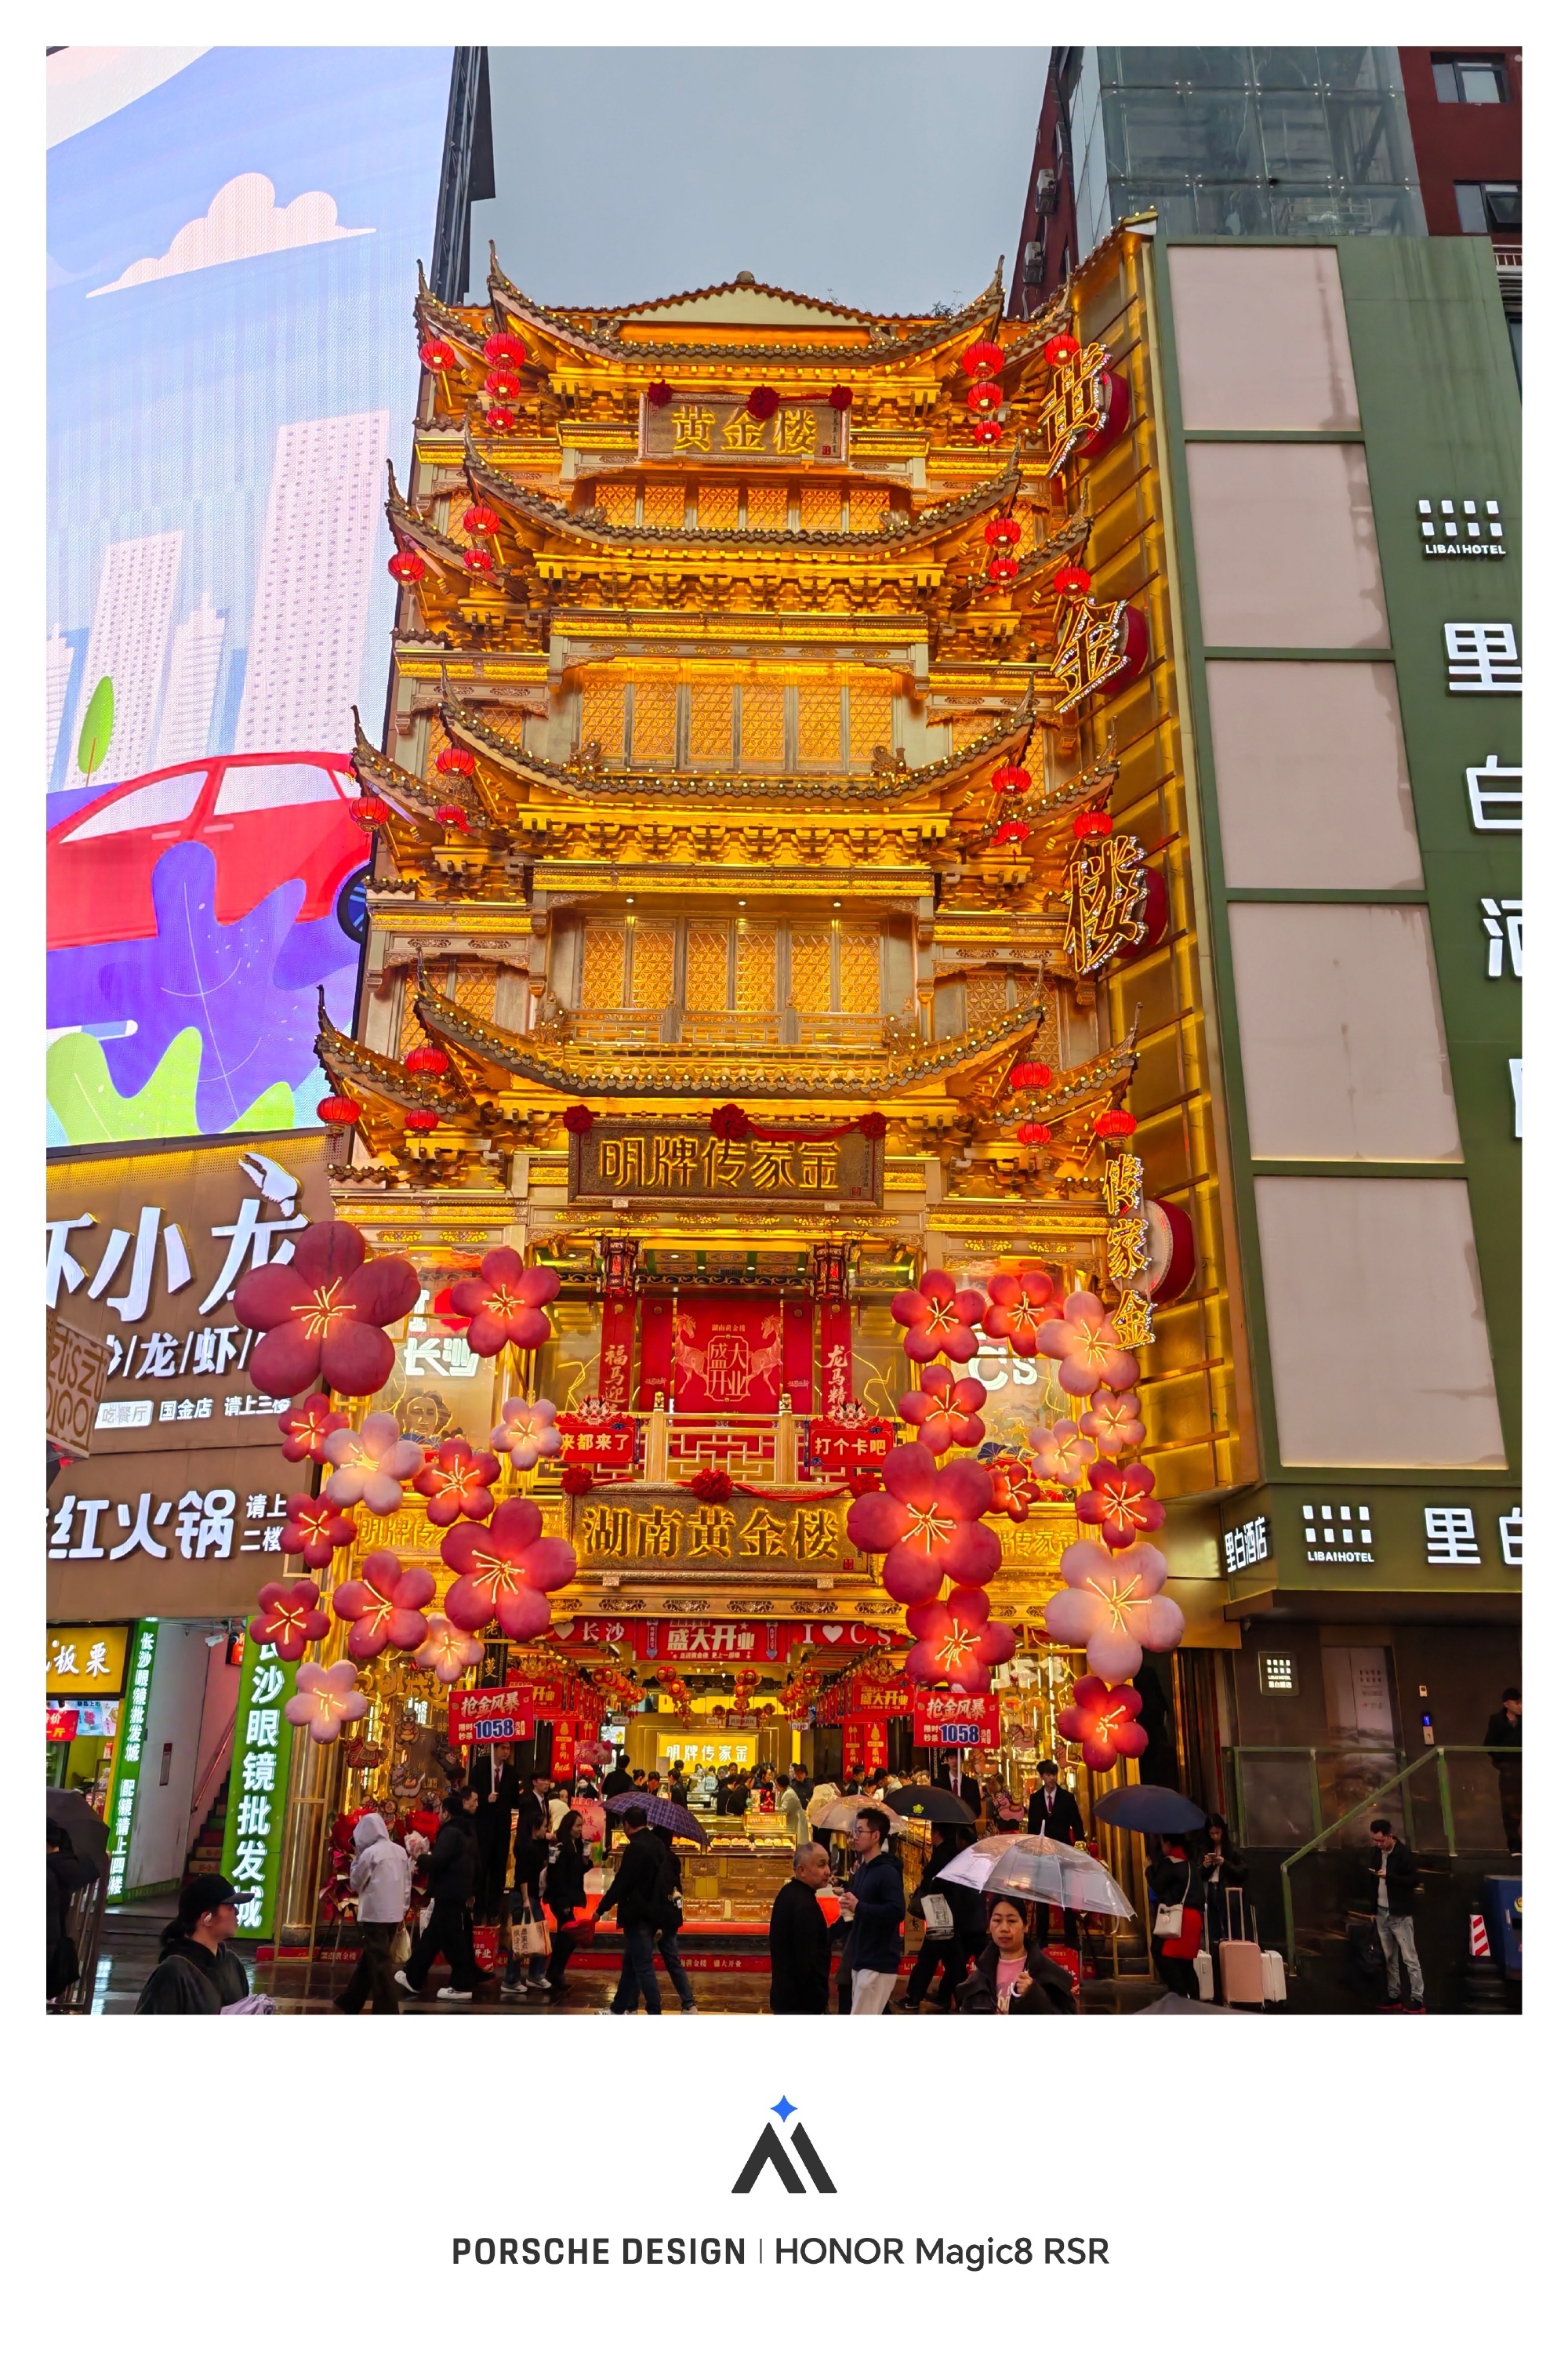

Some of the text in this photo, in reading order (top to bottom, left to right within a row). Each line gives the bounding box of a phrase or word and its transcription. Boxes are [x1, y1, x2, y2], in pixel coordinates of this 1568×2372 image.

[671, 405, 818, 454] 黄金楼
[601, 1135, 840, 1192] 明牌传家金
[404, 1338, 479, 1377] 长沙
[710, 1342, 747, 1368] 盛大
[604, 1345, 629, 1413] 福马迎
[709, 1369, 745, 1397] 开业
[824, 1344, 848, 1416] 龙马精
[97, 1404, 148, 1424] 吃餐厅
[158, 1398, 213, 1422] 国金店
[560, 1433, 629, 1451] 来都来了
[815, 1437, 887, 1457] 打个卡吧
[246, 1494, 287, 1518] 请上
[46, 1489, 236, 1560] 红火锅
[583, 1506, 839, 1560] 湖南黄金楼
[240, 1526, 284, 1551] 二楼
[1225, 1517, 1268, 1573] 里白酒店
[581, 1622, 625, 1641] 长沙
[667, 1626, 755, 1651] 盛大开业
[802, 1623, 814, 1644] I
[46, 1640, 110, 1677] 板栗
[125, 1632, 154, 1762] 长沙眼镜批发城
[461, 1691, 521, 1719] 抢金风暴
[926, 1698, 986, 1722] 抢金风暴
[474, 1717, 514, 1739] 1058
[939, 1724, 980, 1744] 1058
[666, 1745, 749, 1763] 明牌传家金
